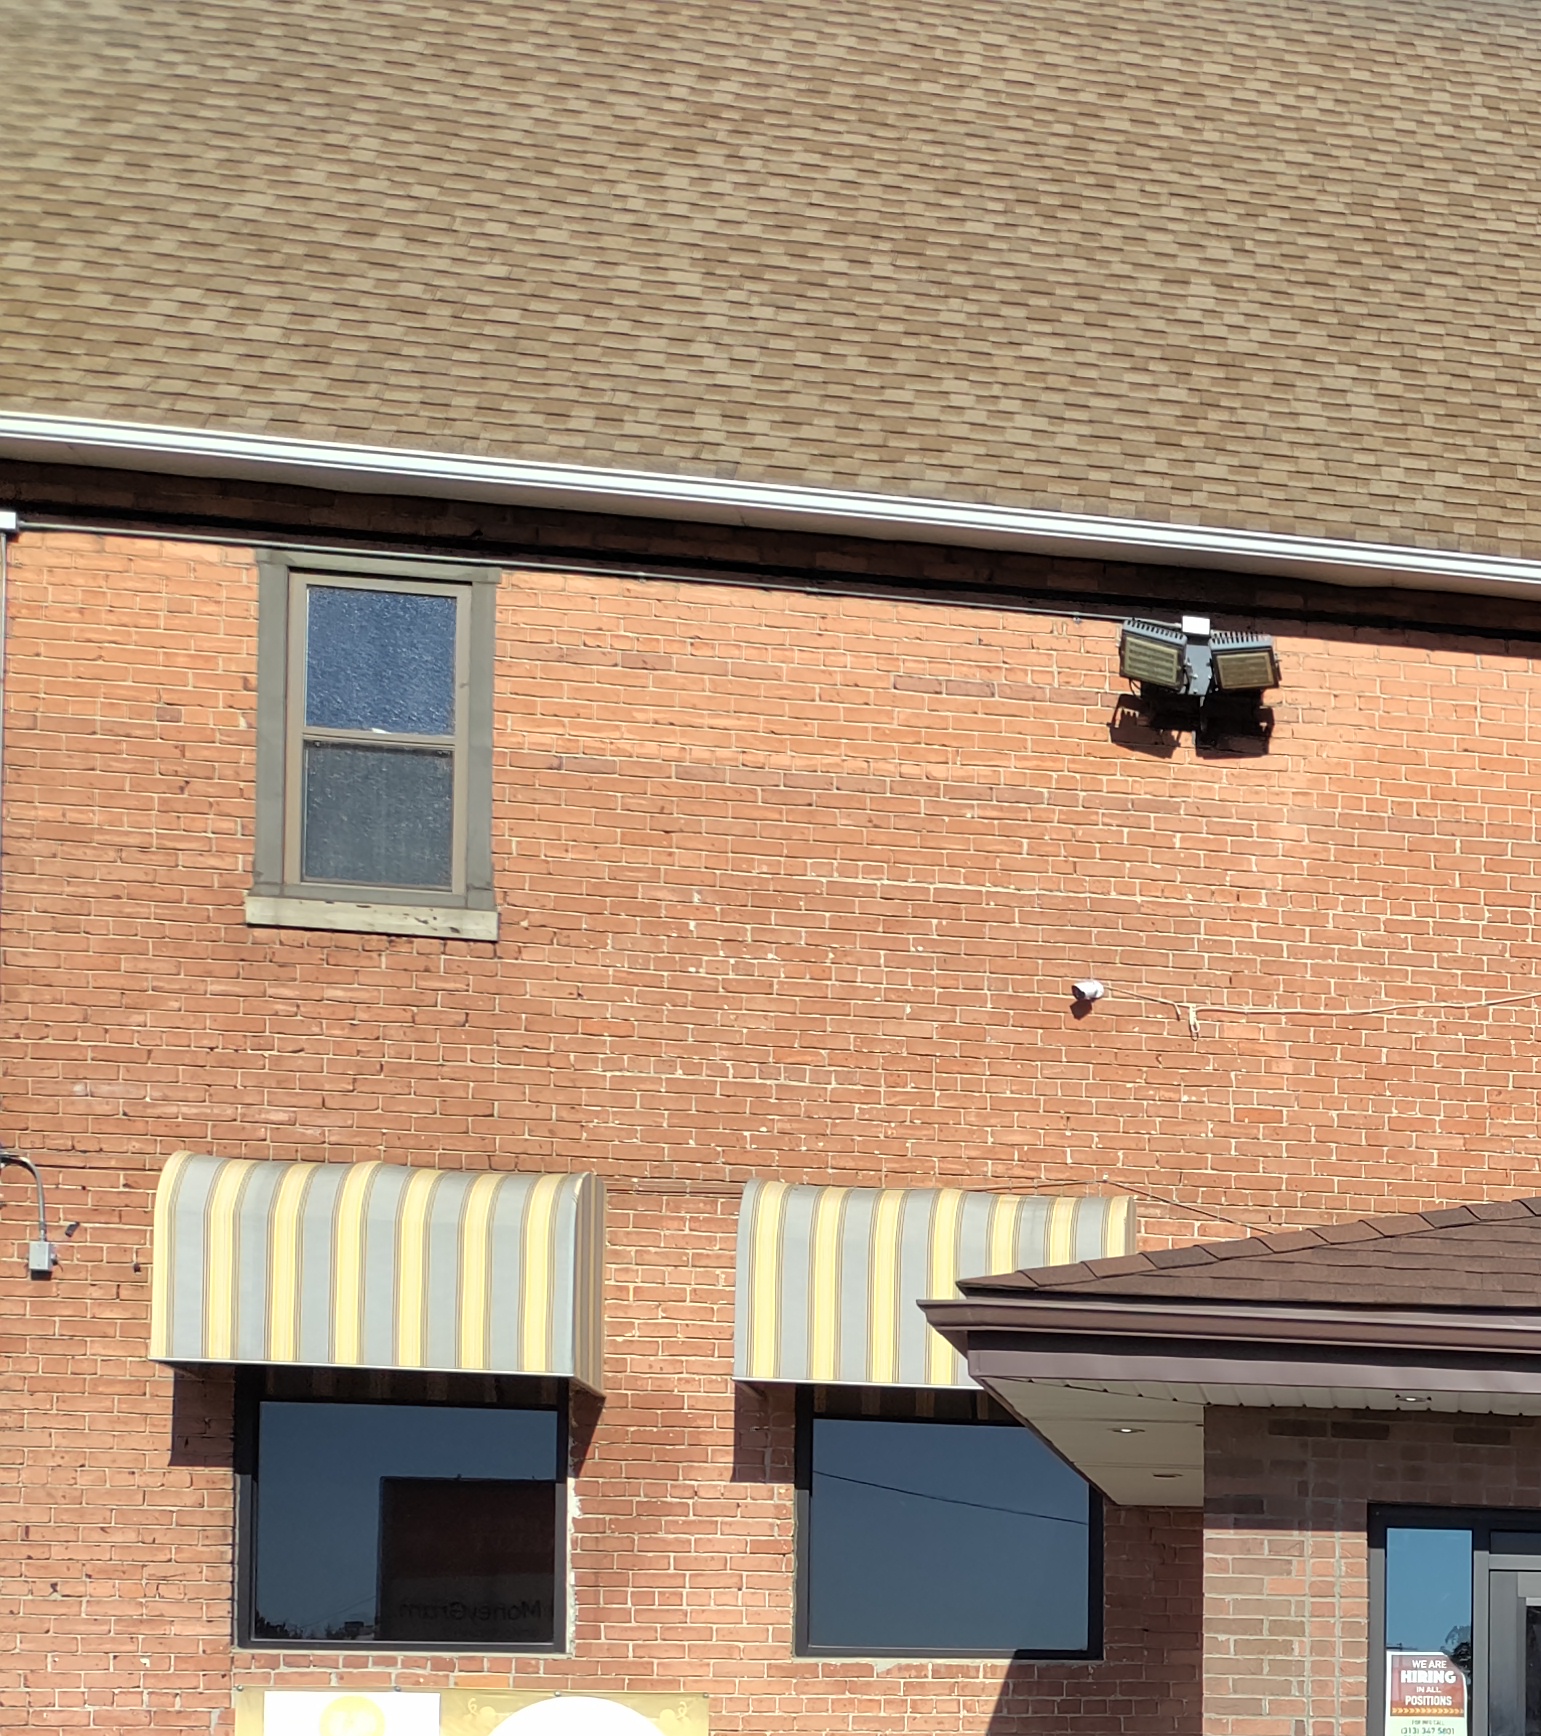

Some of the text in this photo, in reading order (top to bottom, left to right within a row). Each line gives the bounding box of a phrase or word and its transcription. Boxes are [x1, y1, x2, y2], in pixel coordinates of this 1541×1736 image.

[1412, 1660, 1447, 1669] WE ARE
[1400, 1670, 1456, 1684] HIRING
[1405, 1696, 1452, 1706] POSITIONS
